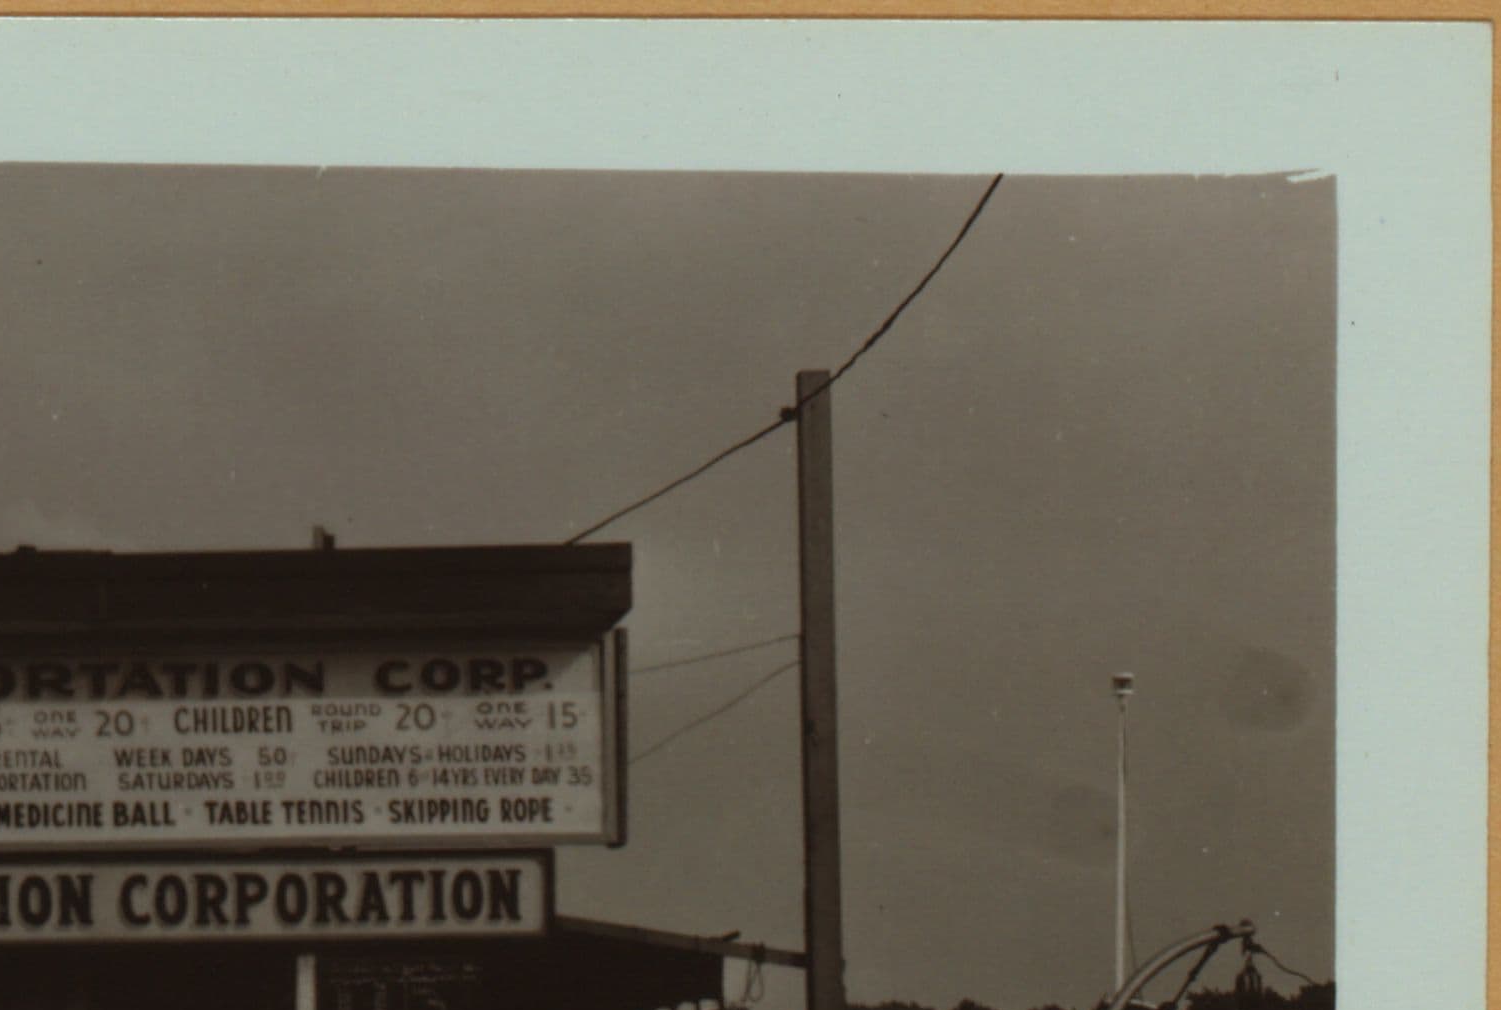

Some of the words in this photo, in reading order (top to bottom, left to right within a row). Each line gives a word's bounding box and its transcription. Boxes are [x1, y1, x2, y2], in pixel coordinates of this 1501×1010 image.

[373, 656, 554, 695] CORP.
[318, 719, 366, 733] TRIP
[475, 717, 532, 729] WAY
[31, 727, 81, 739] WAY
[114, 747, 172, 768] WEEK
[182, 746, 233, 767] DAYS
[438, 744, 526, 763] HOLIDAYS
[117, 771, 235, 791] SATURDAYS
[484, 767, 525, 785] EVERY
[531, 766, 562, 785] DAY
[112, 800, 177, 827] BALL
[205, 799, 273, 826] TABLE
[500, 796, 554, 824] ROPE
[119, 868, 523, 927] CORPORATION
